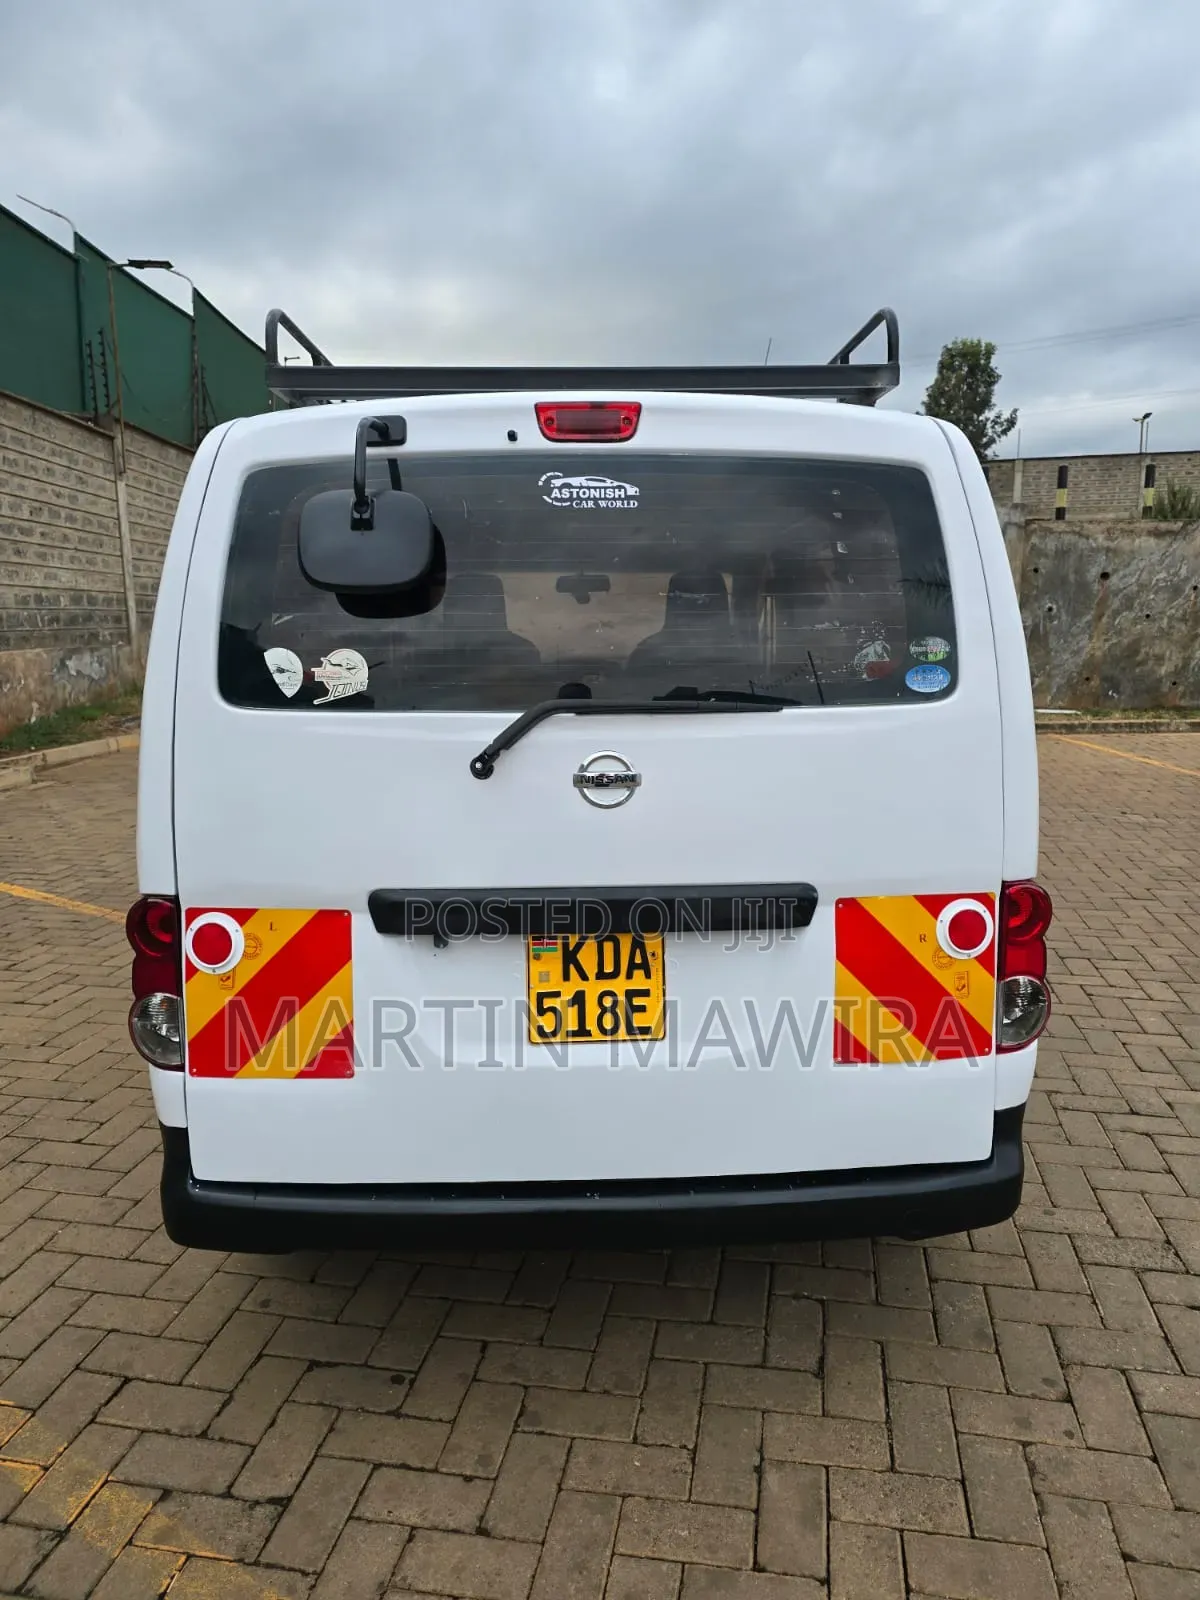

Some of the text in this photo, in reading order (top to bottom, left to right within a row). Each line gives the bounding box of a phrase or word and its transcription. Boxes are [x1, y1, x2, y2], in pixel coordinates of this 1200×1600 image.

[551, 488, 625, 498] ASTONISH
[572, 500, 639, 508] CAR WORLD
[578, 774, 637, 785] NISSAN
[919, 933, 928, 943] R
[562, 933, 652, 982] KDA
[536, 987, 653, 1039] 518E
